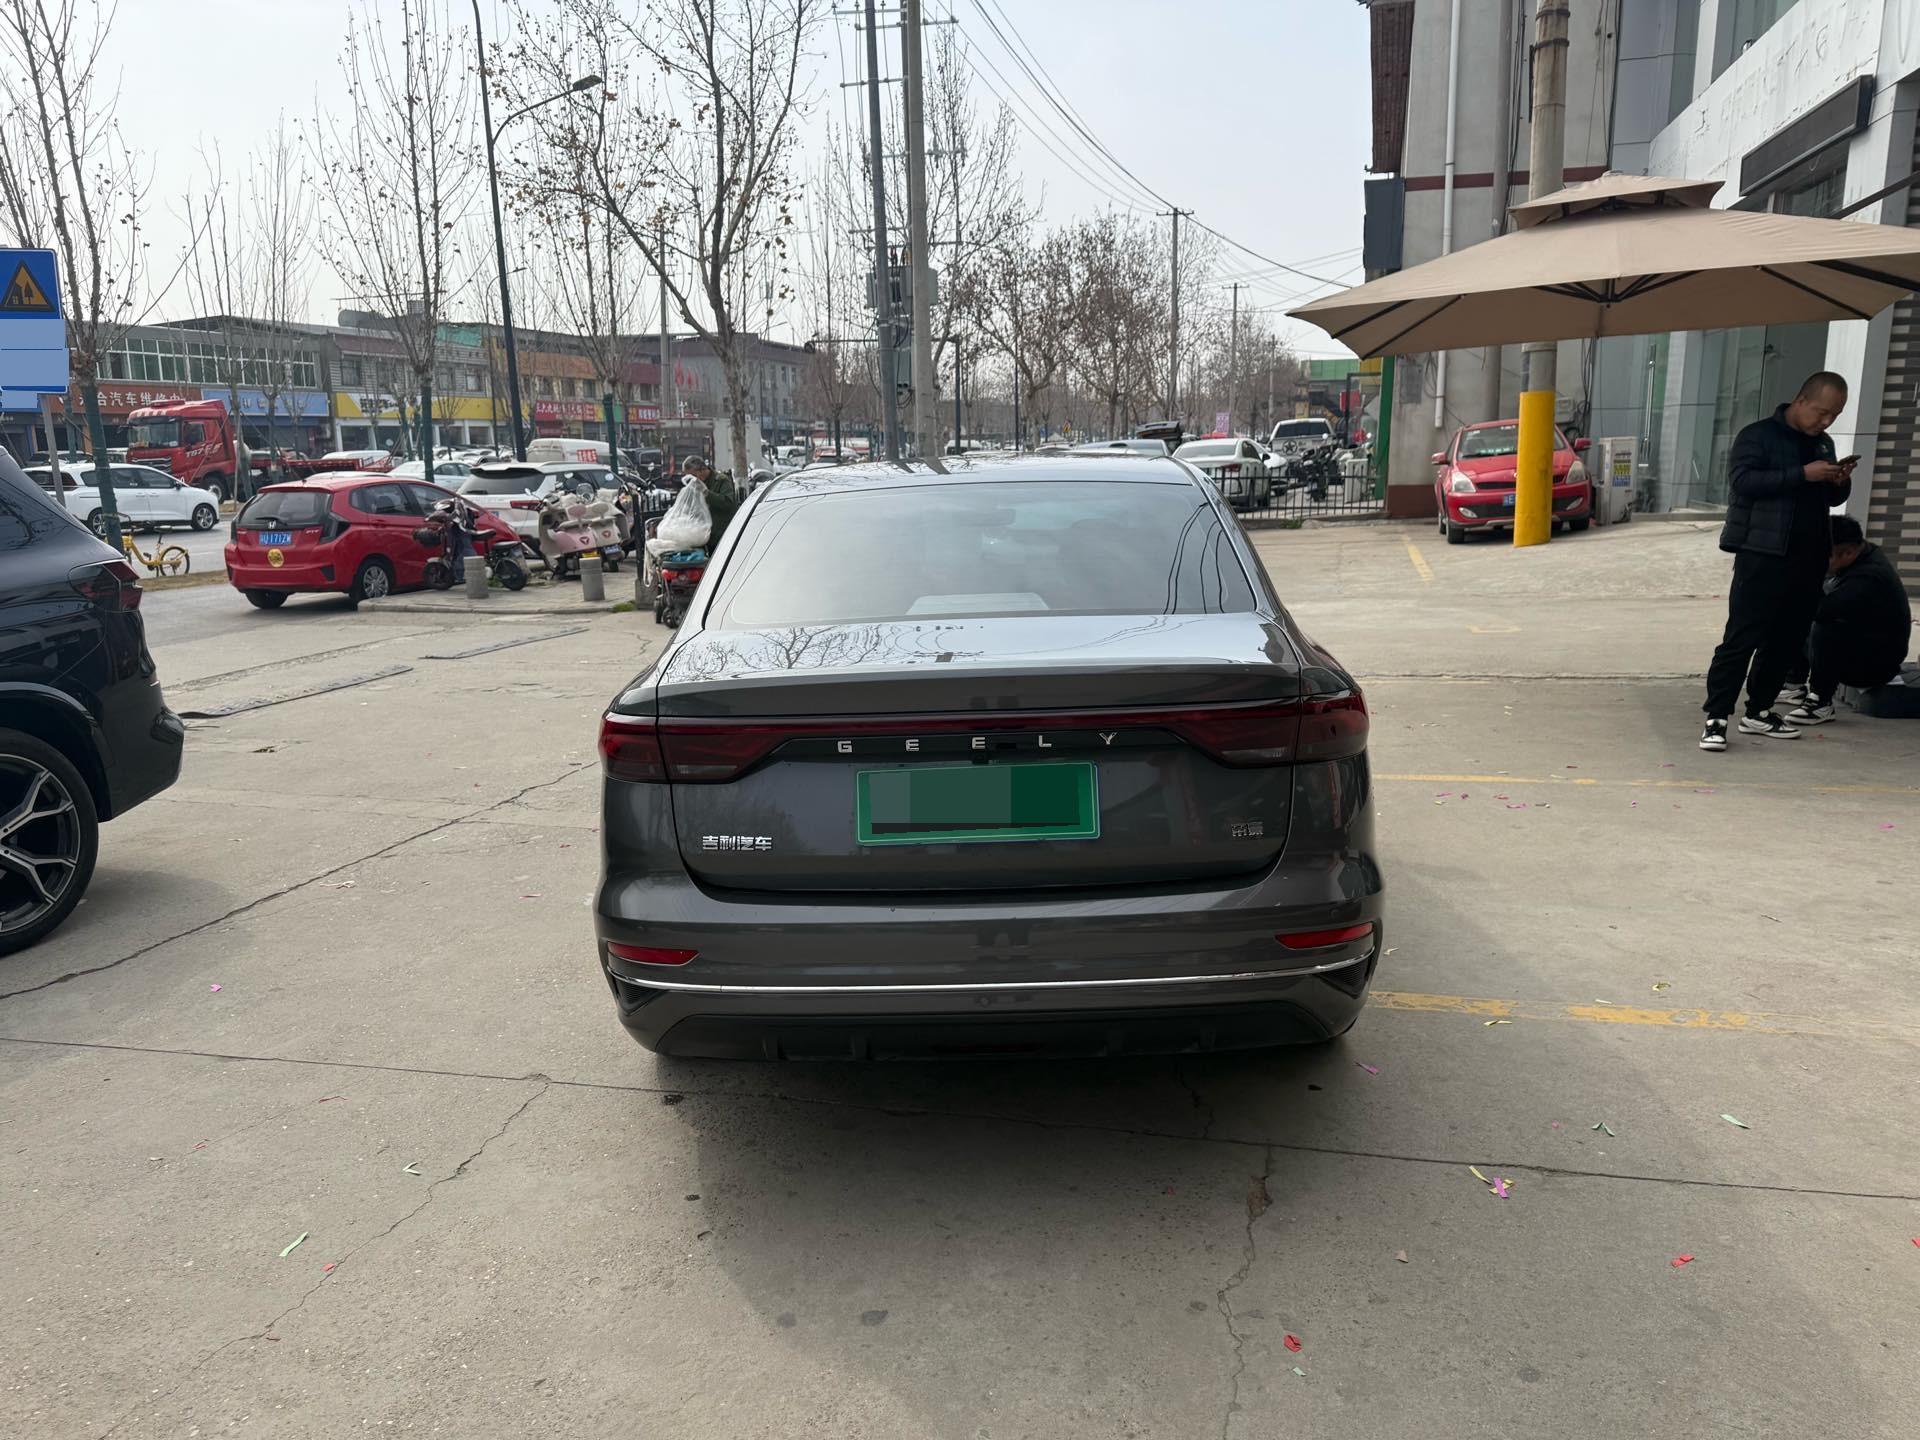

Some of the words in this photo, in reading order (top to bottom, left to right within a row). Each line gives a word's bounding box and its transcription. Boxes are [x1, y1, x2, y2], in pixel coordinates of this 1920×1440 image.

[837, 731, 1118, 754] GEELY
[702, 834, 772, 851] 吉利汽车
